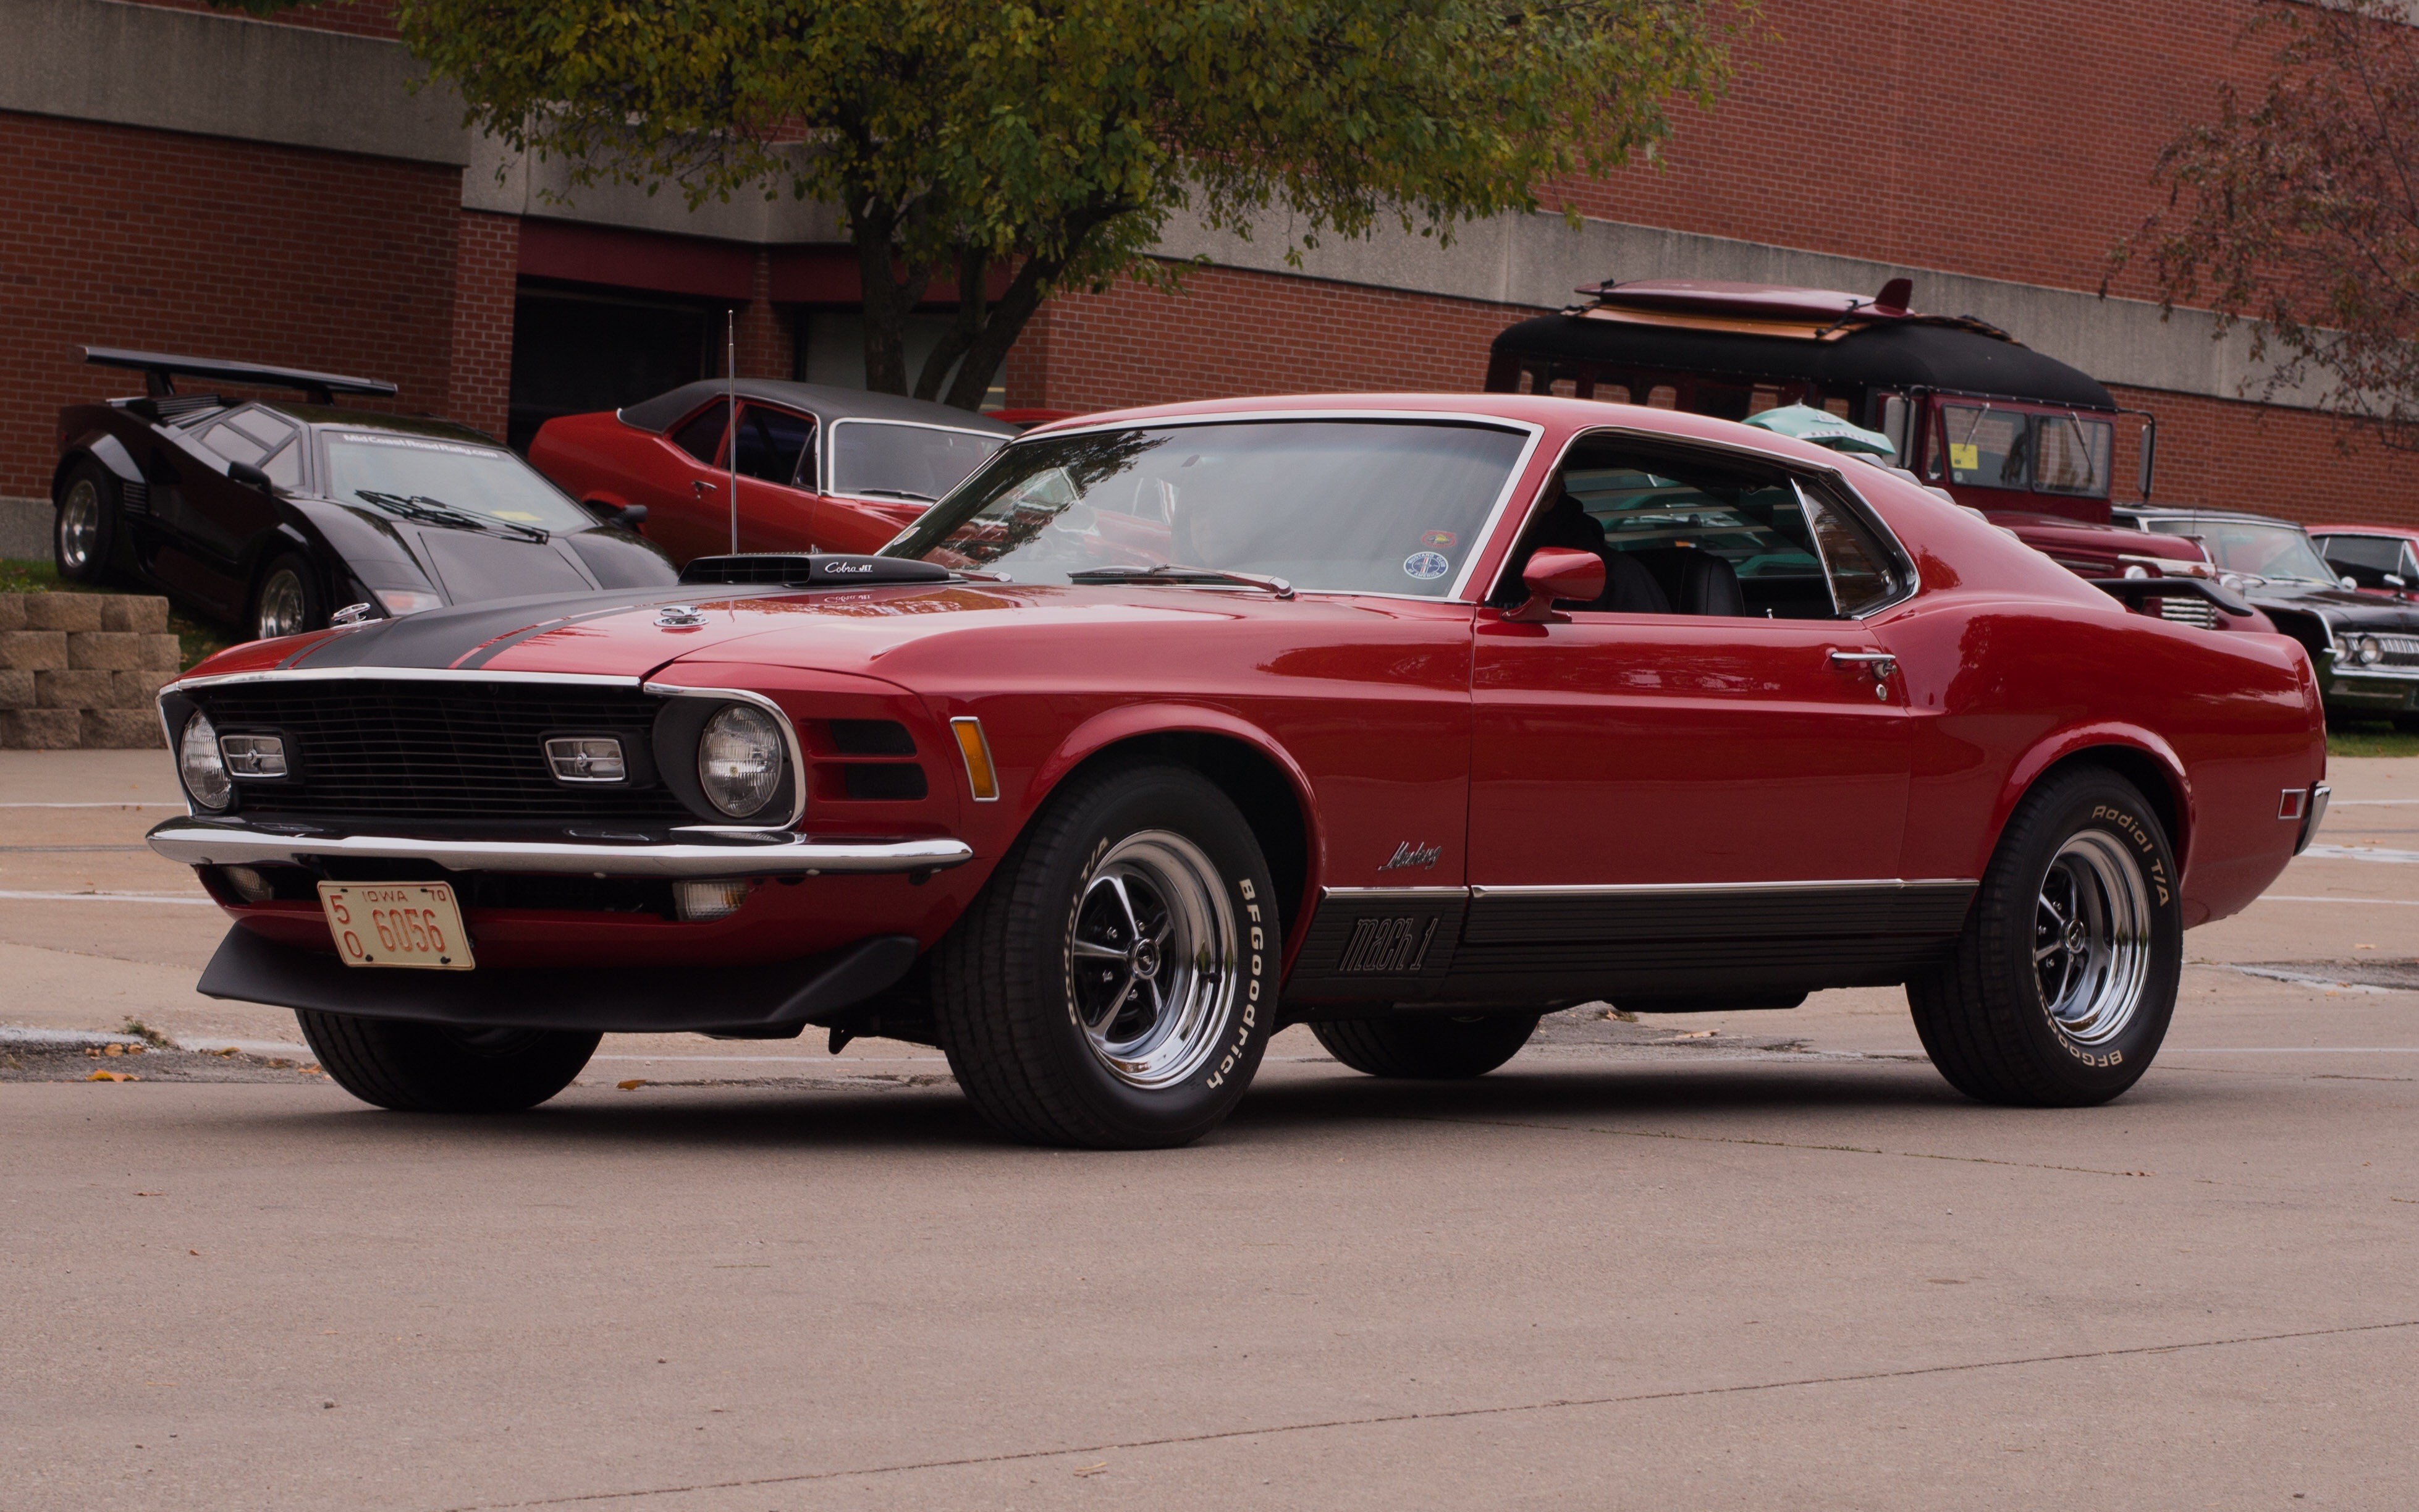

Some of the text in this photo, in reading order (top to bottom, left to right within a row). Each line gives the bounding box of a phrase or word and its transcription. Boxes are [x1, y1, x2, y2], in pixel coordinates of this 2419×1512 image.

[824, 561, 873, 573] Cobra JET
[2091, 805, 2169, 907] Radial T/A
[361, 890, 447, 903] IOWA 70
[372, 908, 445, 953] 6056
[1207, 878, 1264, 1090] BFGoodrich
